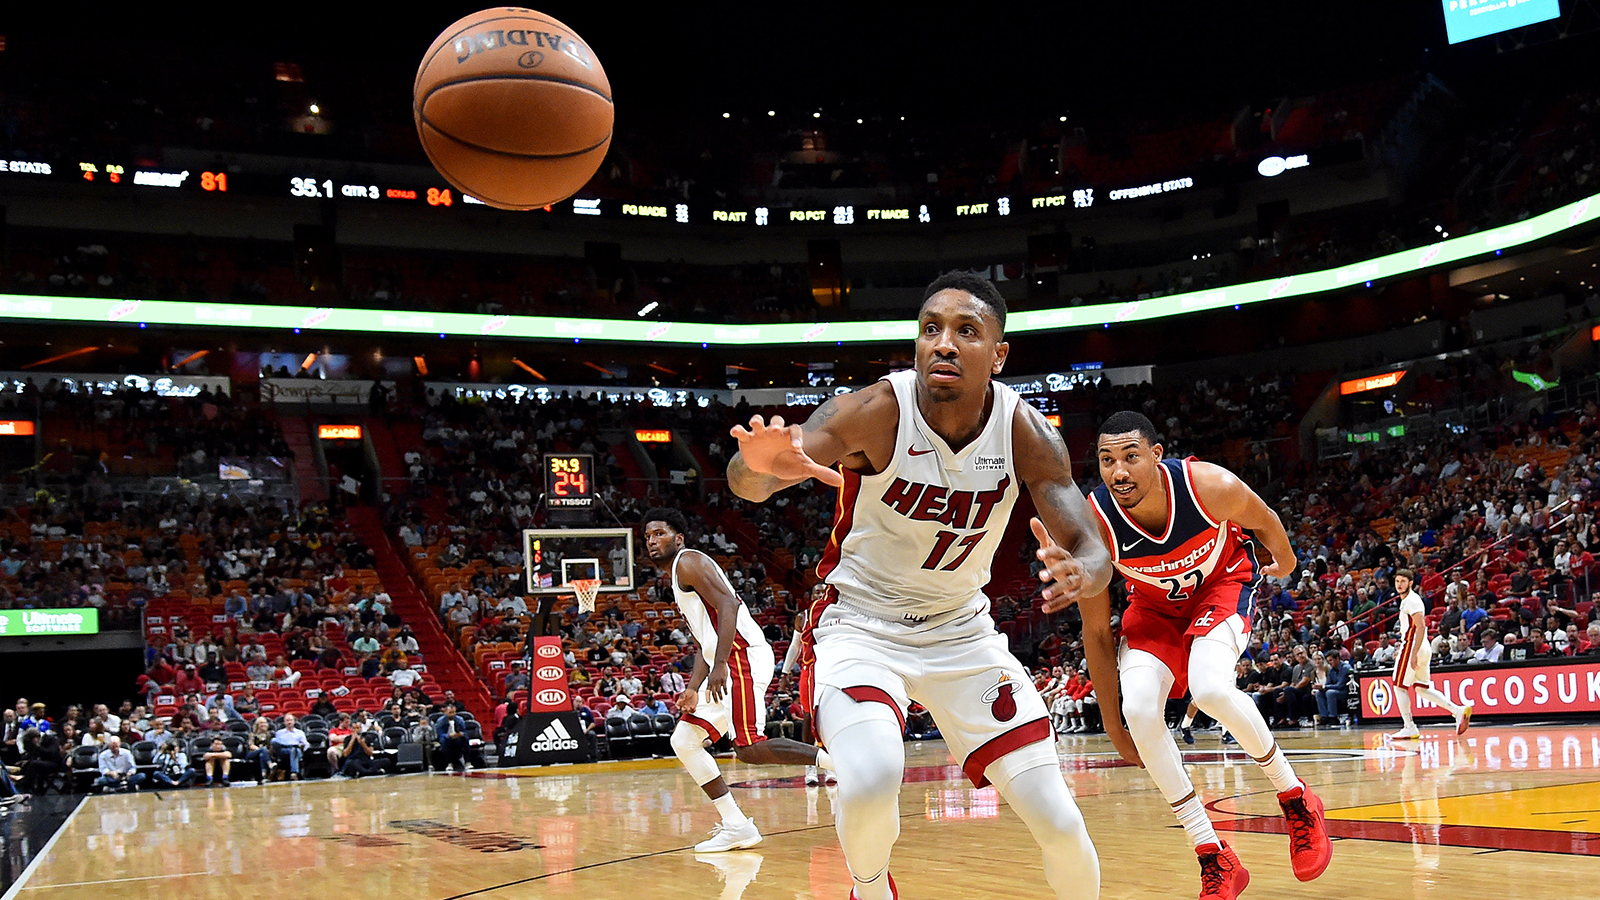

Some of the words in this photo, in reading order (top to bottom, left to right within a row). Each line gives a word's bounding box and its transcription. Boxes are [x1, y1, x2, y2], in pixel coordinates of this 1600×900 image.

[9, 161, 51, 174] STATS
[200, 171, 227, 192] 81
[290, 177, 333, 198] 35.1
[341, 185, 367, 197] QTR
[368, 186, 380, 199] 3
[1109, 182, 1161, 200] OFFENSIVE
[1162, 177, 1193, 192] STATS
[426, 187, 452, 206] 84
[1032, 198, 1045, 208] FT
[1046, 195, 1066, 206] PCT
[638, 205, 667, 217] MADE
[806, 210, 826, 220] PCT
[867, 210, 880, 219] FT
[881, 209, 909, 219] MADE
[957, 205, 969, 215] FT
[970, 203, 988, 214] ATT
[728, 211, 747, 221] ATT
[551, 458, 579, 472] 34.9
[975, 456, 1005, 465] Ultimate
[554, 471, 585, 496] 24
[880, 472, 1011, 529] HEAT
[921, 529, 989, 571] 17
[1128, 538, 1216, 573] washington
[22, 611, 83, 625] Ultimate
[26, 623, 81, 632] SOFTWARE
[541, 647, 557, 655] KIA
[541, 668, 559, 678] KIA
[540, 692, 562, 702] KIA
[531, 738, 579, 752] adidas
